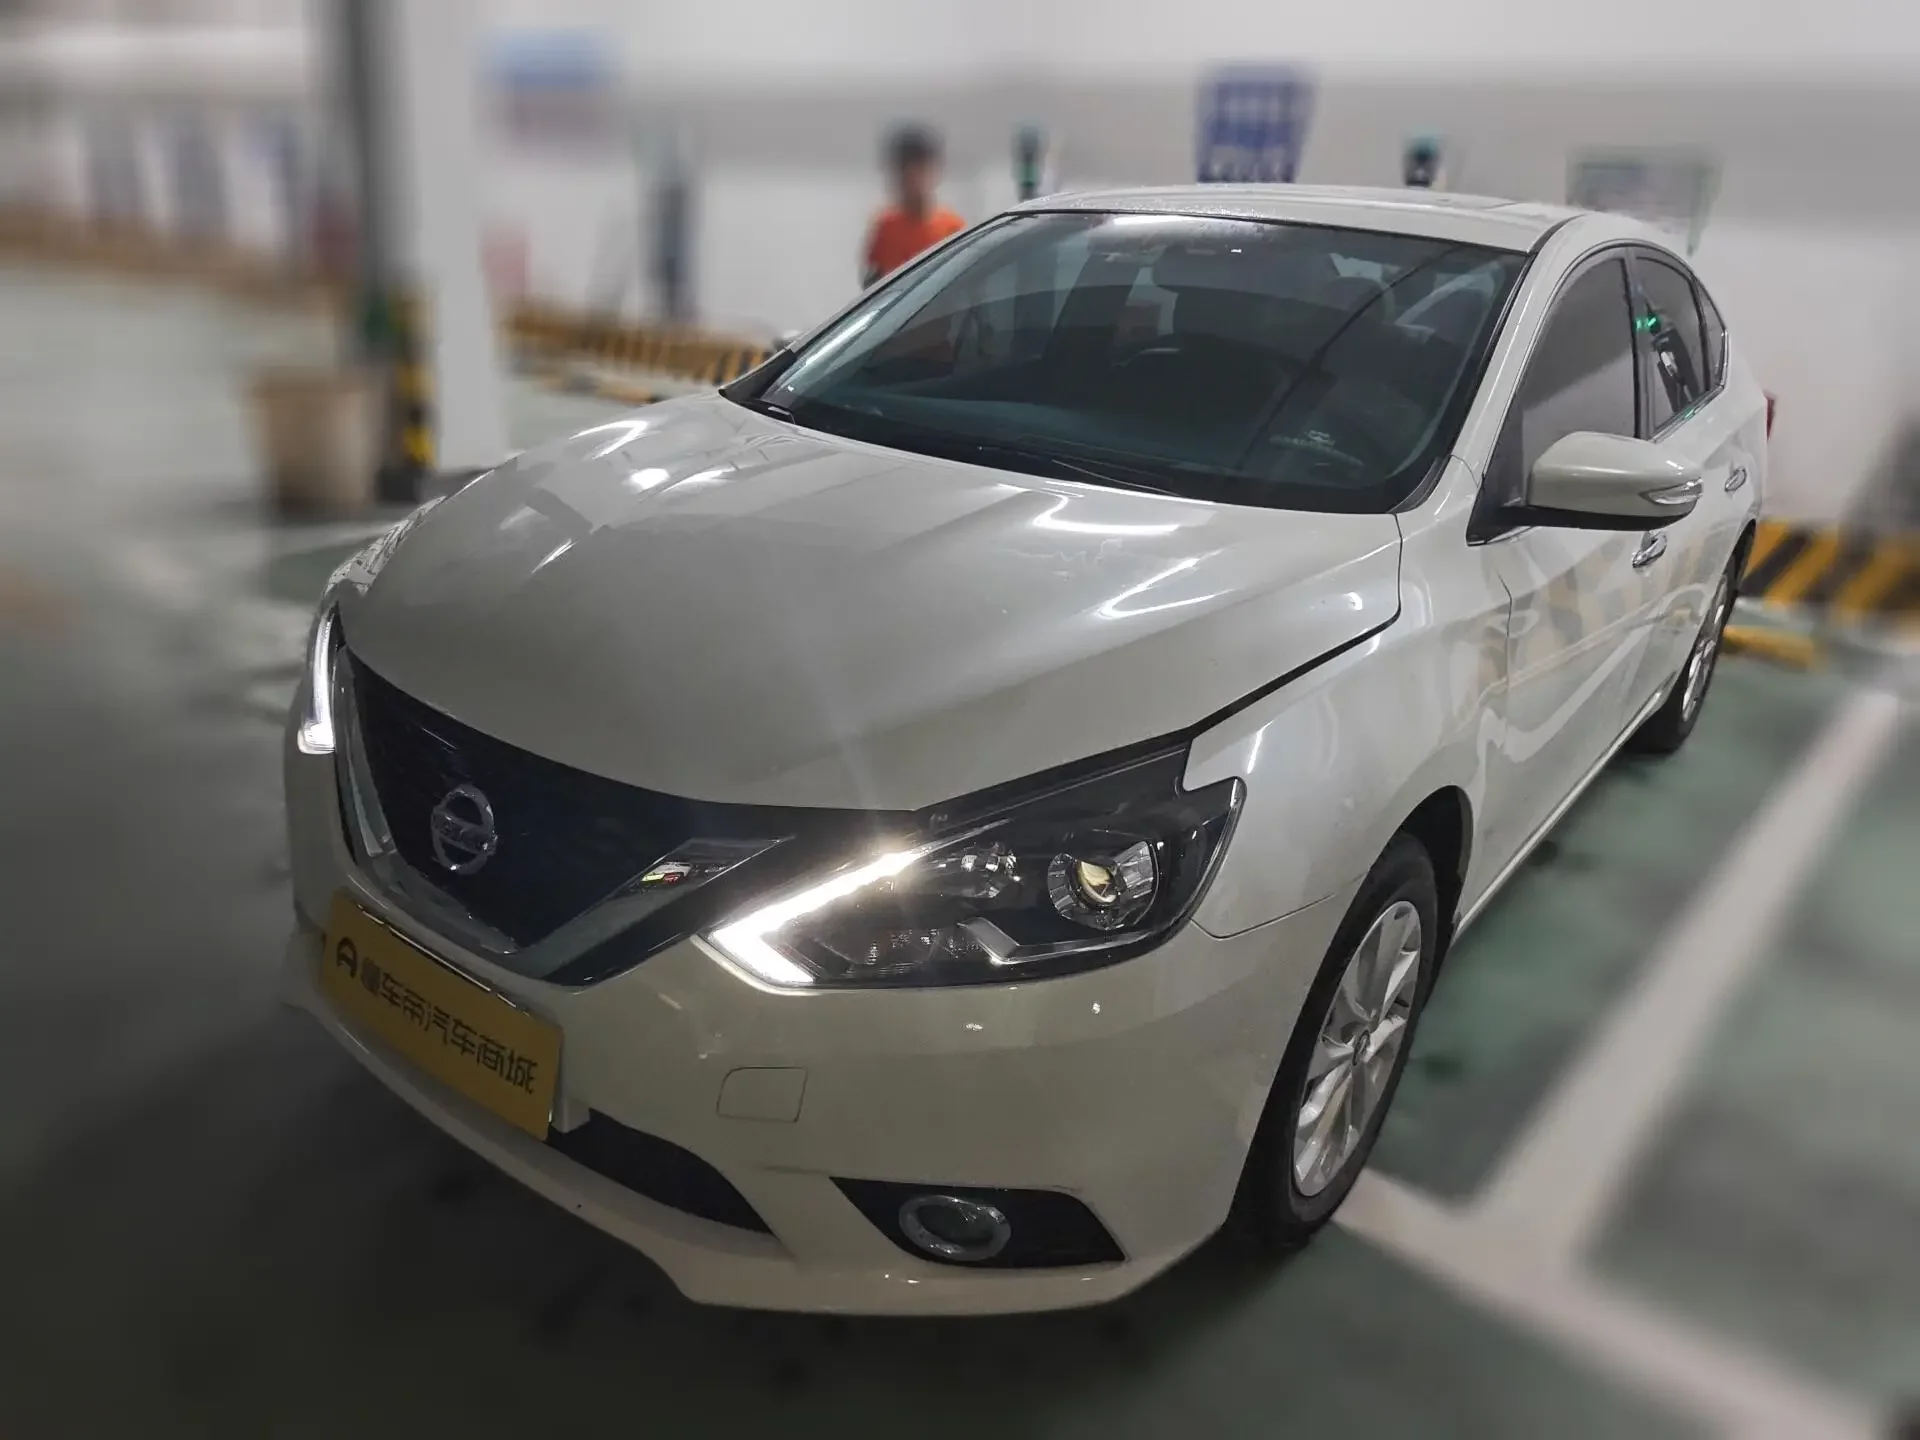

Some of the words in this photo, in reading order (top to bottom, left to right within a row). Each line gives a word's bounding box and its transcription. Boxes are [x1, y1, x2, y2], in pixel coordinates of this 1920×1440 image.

[360, 956, 538, 1095] 车帝汽车商城
